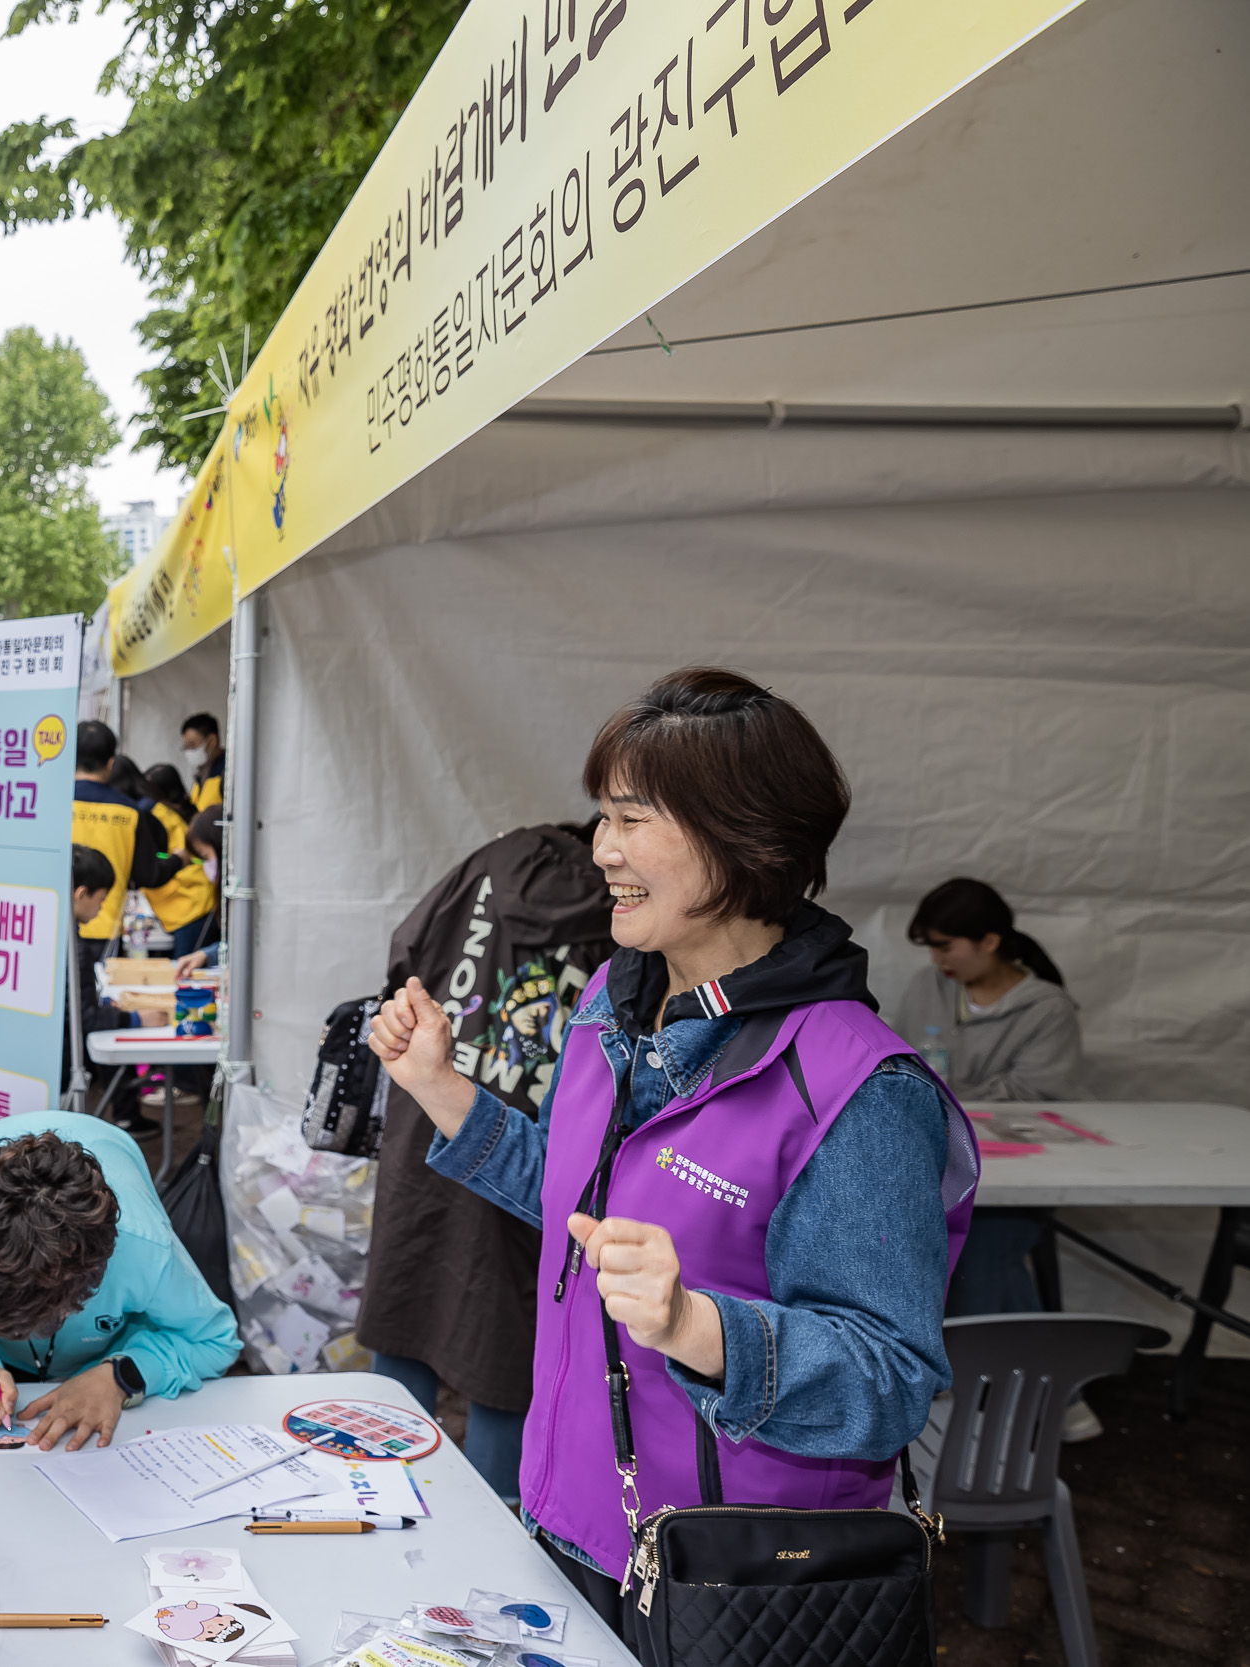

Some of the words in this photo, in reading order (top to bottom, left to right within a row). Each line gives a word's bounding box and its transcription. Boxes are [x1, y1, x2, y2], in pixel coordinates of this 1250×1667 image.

[420, 14, 527, 250] 바람개비
[366, 150, 594, 455] 민주평화통일자문회의
[38, 731, 62, 745] TALK
